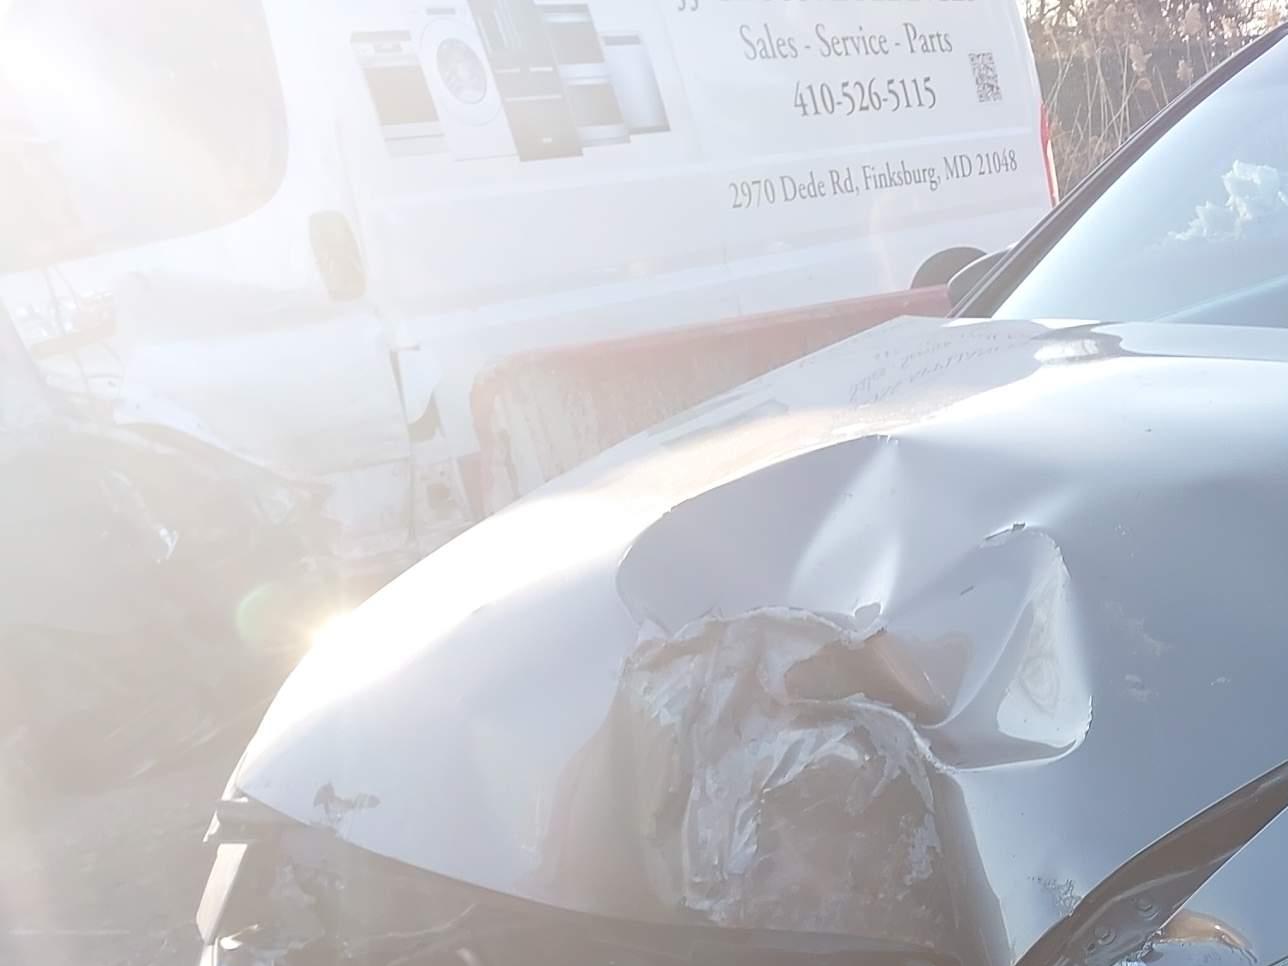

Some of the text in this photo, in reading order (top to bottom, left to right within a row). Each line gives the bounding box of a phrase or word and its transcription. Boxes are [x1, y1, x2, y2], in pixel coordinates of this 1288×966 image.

[739, 23, 798, 61] Sales
[815, 22, 889, 58] Service
[903, 21, 953, 54] Parts
[794, 76, 936, 117] 410-526-5115
[729, 149, 1018, 208] 2970 Dede Rd, Finksburg, MD 21048
